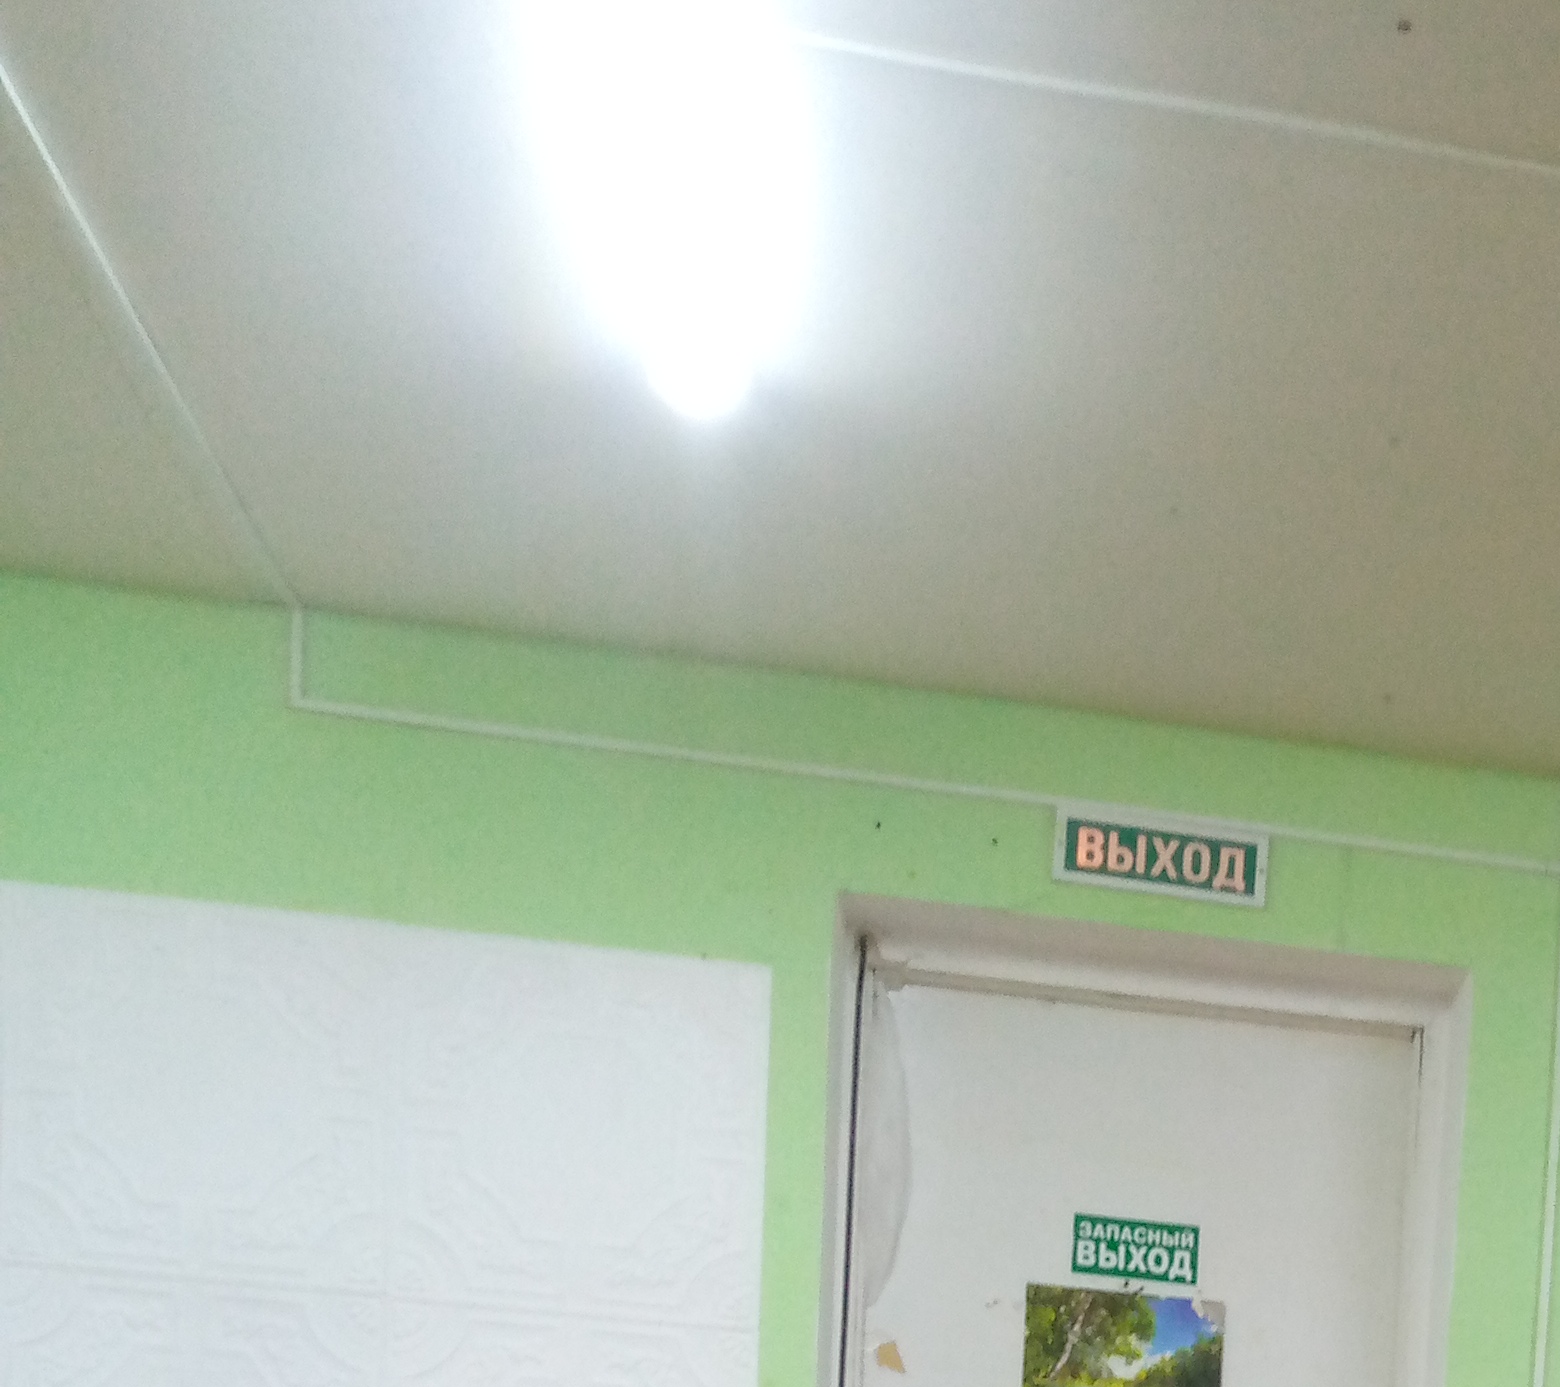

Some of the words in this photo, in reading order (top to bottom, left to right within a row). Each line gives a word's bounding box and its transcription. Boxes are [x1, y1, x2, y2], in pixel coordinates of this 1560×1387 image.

[1076, 825, 1246, 892] ВЫХОД
[1079, 1220, 1195, 1248] ЗАПАСНЫЙ
[1076, 1240, 1193, 1282] ВЫХОД
